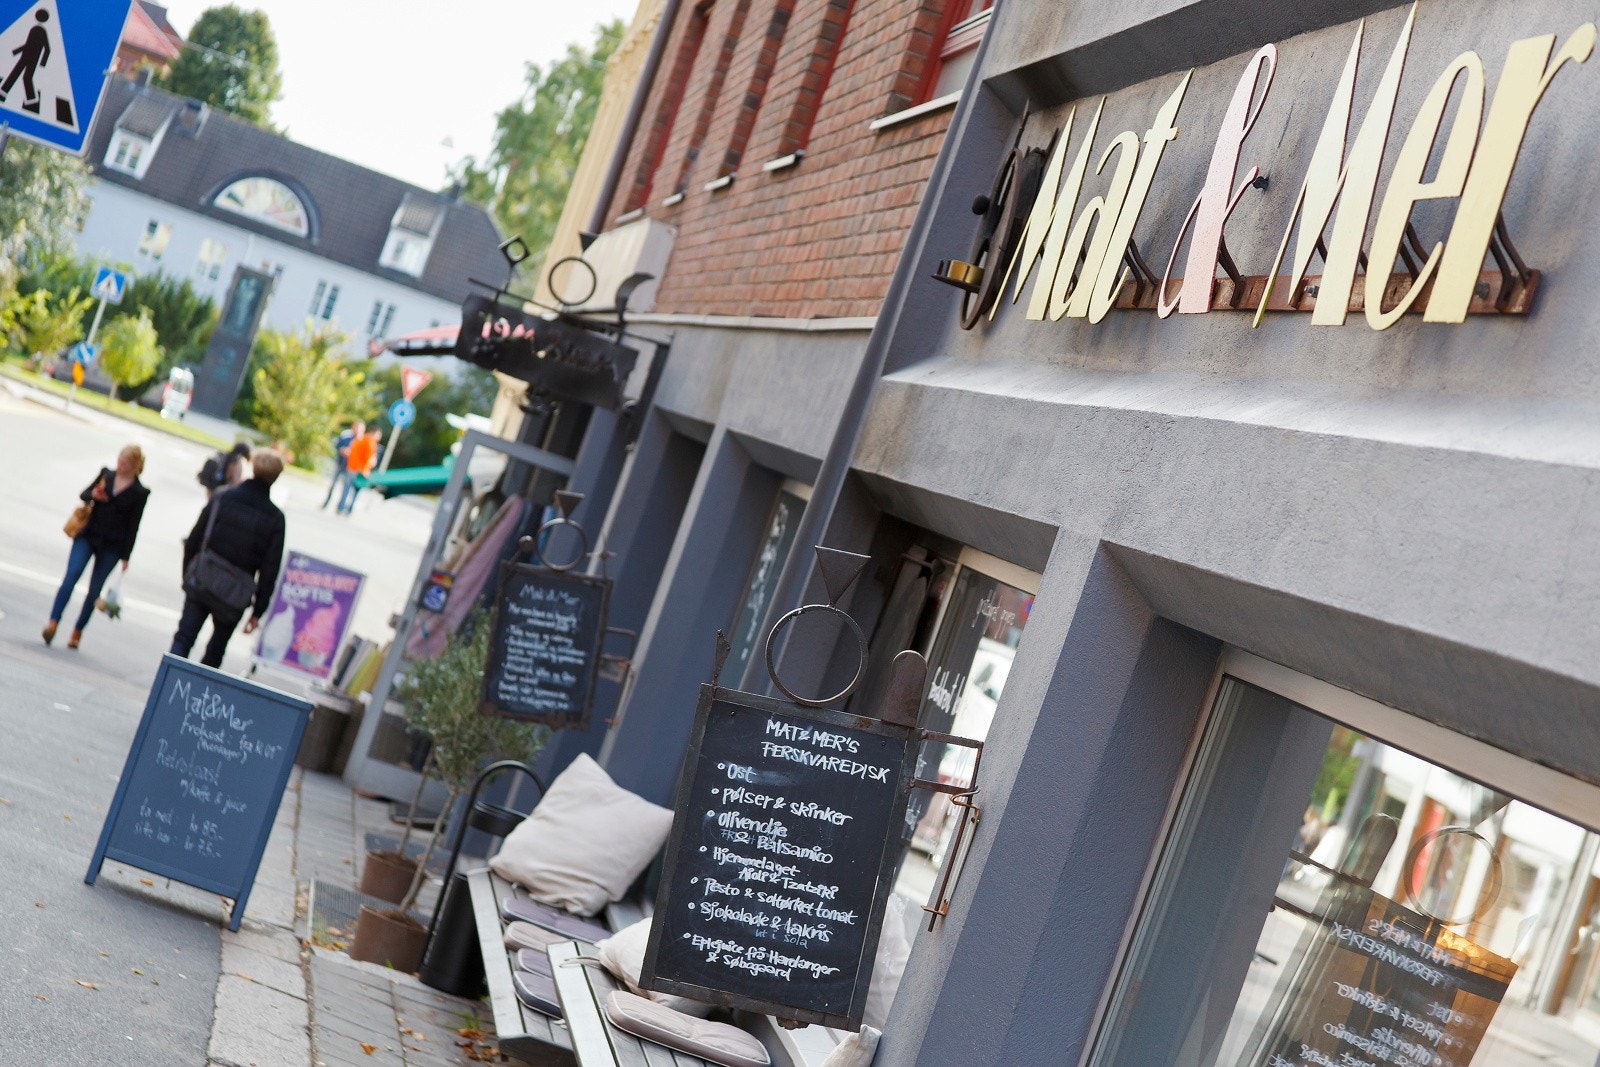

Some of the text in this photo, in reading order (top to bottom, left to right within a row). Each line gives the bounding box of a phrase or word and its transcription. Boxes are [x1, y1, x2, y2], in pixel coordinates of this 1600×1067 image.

[990, 0, 1598, 331] Mat & Mer
[727, 763, 757, 783] Ost
[761, 741, 891, 783] FERSKVAREDISK
[773, 797, 787, 809] &
[790, 801, 853, 826] skinker
[713, 846, 800, 877] Hjemmelaget
[757, 835, 833, 864] Balsamico
[768, 872, 780, 884] &
[780, 877, 840, 900] Tzatziki
[704, 878, 741, 896] Pesto
[744, 888, 755, 899] &
[815, 901, 859, 925] tomat
[769, 916, 784, 930] &
[786, 917, 833, 942] lakris
[691, 934, 745, 954] Eplejuice
[769, 950, 840, 979] Hardanger
[706, 952, 719, 963] &
